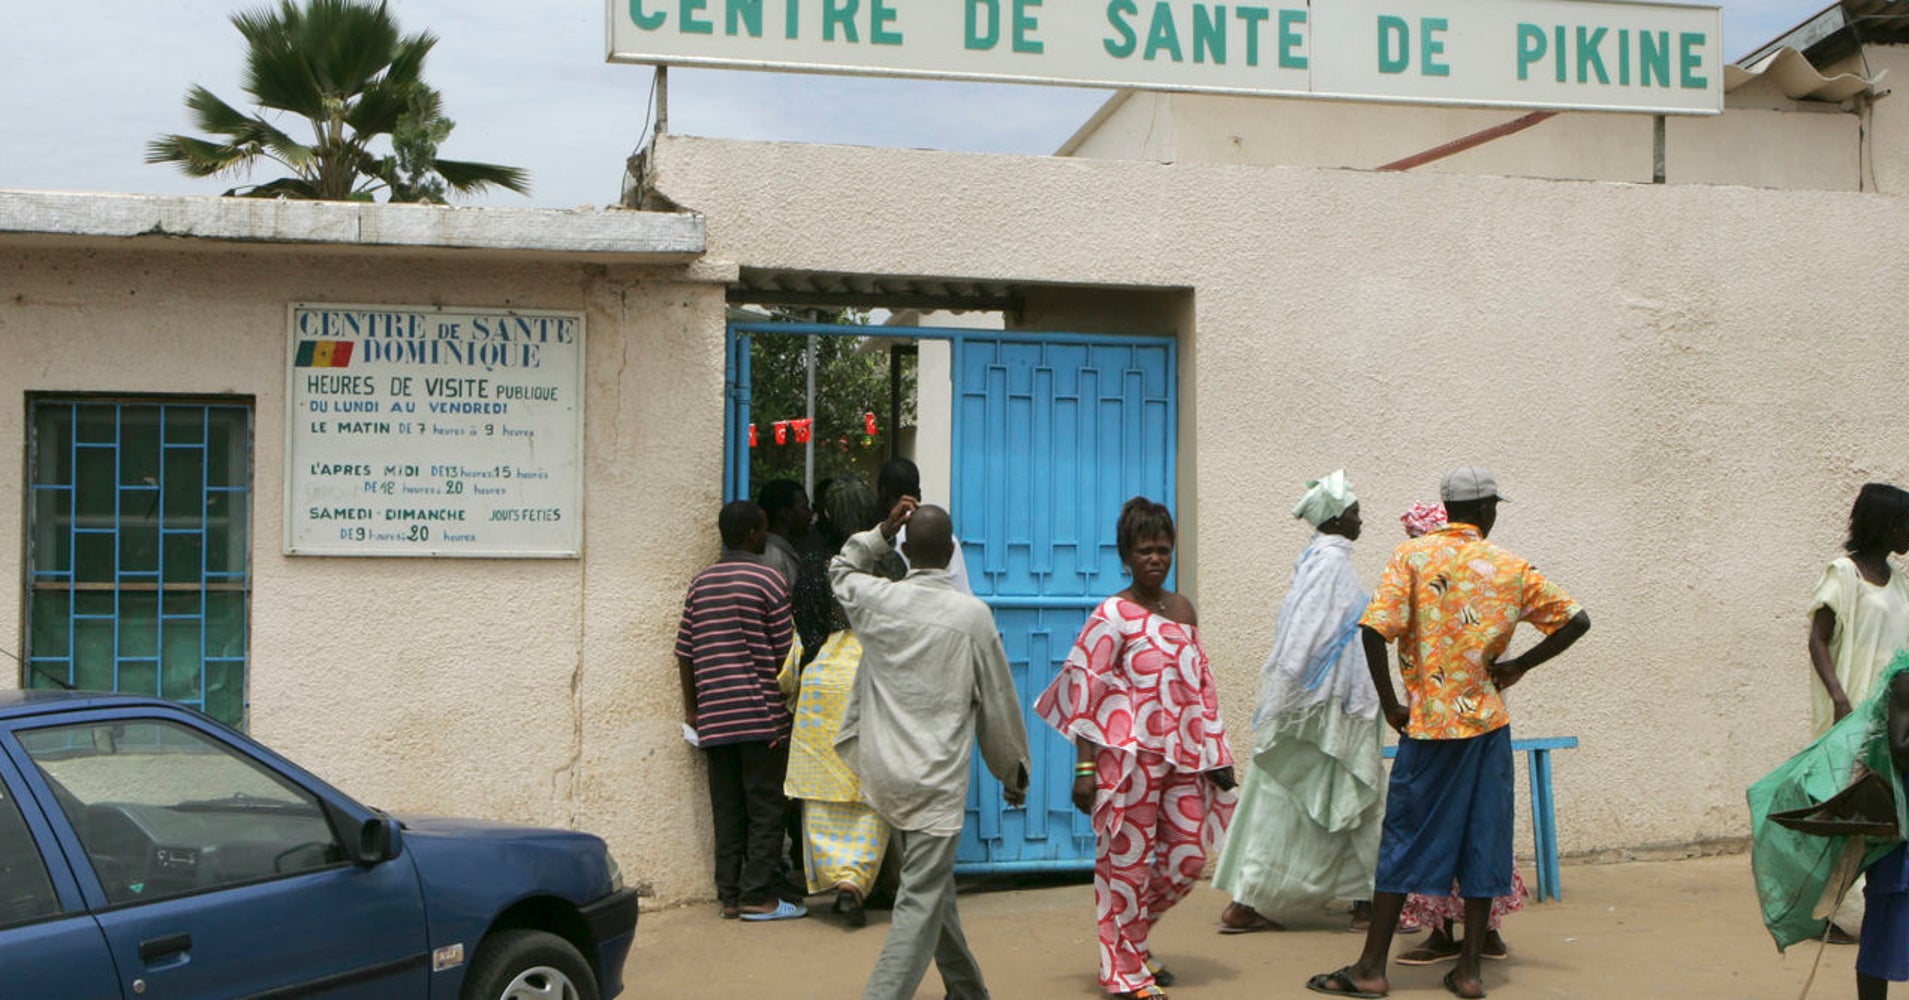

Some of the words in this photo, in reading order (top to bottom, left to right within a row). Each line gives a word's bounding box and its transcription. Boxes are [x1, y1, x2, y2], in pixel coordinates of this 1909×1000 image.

[629, 0, 903, 45] CENTRE
[965, 0, 1044, 54] DE
[1103, 0, 1308, 69] SANTE
[1378, 15, 1450, 76] DE
[1517, 23, 1708, 89] PIKINE
[300, 312, 426, 338] CENTRE
[438, 323, 460, 339] DE
[472, 316, 574, 344] SANTE
[363, 339, 540, 371] DOMINIQUE
[308, 374, 375, 395] HEURES
[390, 377, 413, 396] DE
[425, 378, 489, 398] VISITE
[496, 385, 558, 401] PUBLIQUE
[310, 401, 328, 413] DU
[334, 401, 379, 412] LUNDI
[391, 402, 415, 413] AU
[429, 402, 507, 414] VENDREDI
[311, 422, 327, 433] LE
[338, 422, 390, 434] MATIN
[399, 423, 412, 434] DE
[417, 422, 426, 434] 7
[484, 424, 494, 436] 9
[311, 461, 371, 476] L'APRES
[384, 465, 419, 477] MIDI
[364, 481, 377, 493] DE
[446, 480, 463, 494] 20
[309, 508, 372, 519] SAMEDI
[385, 508, 465, 520] DIMANCHE
[406, 525, 429, 541] 20
